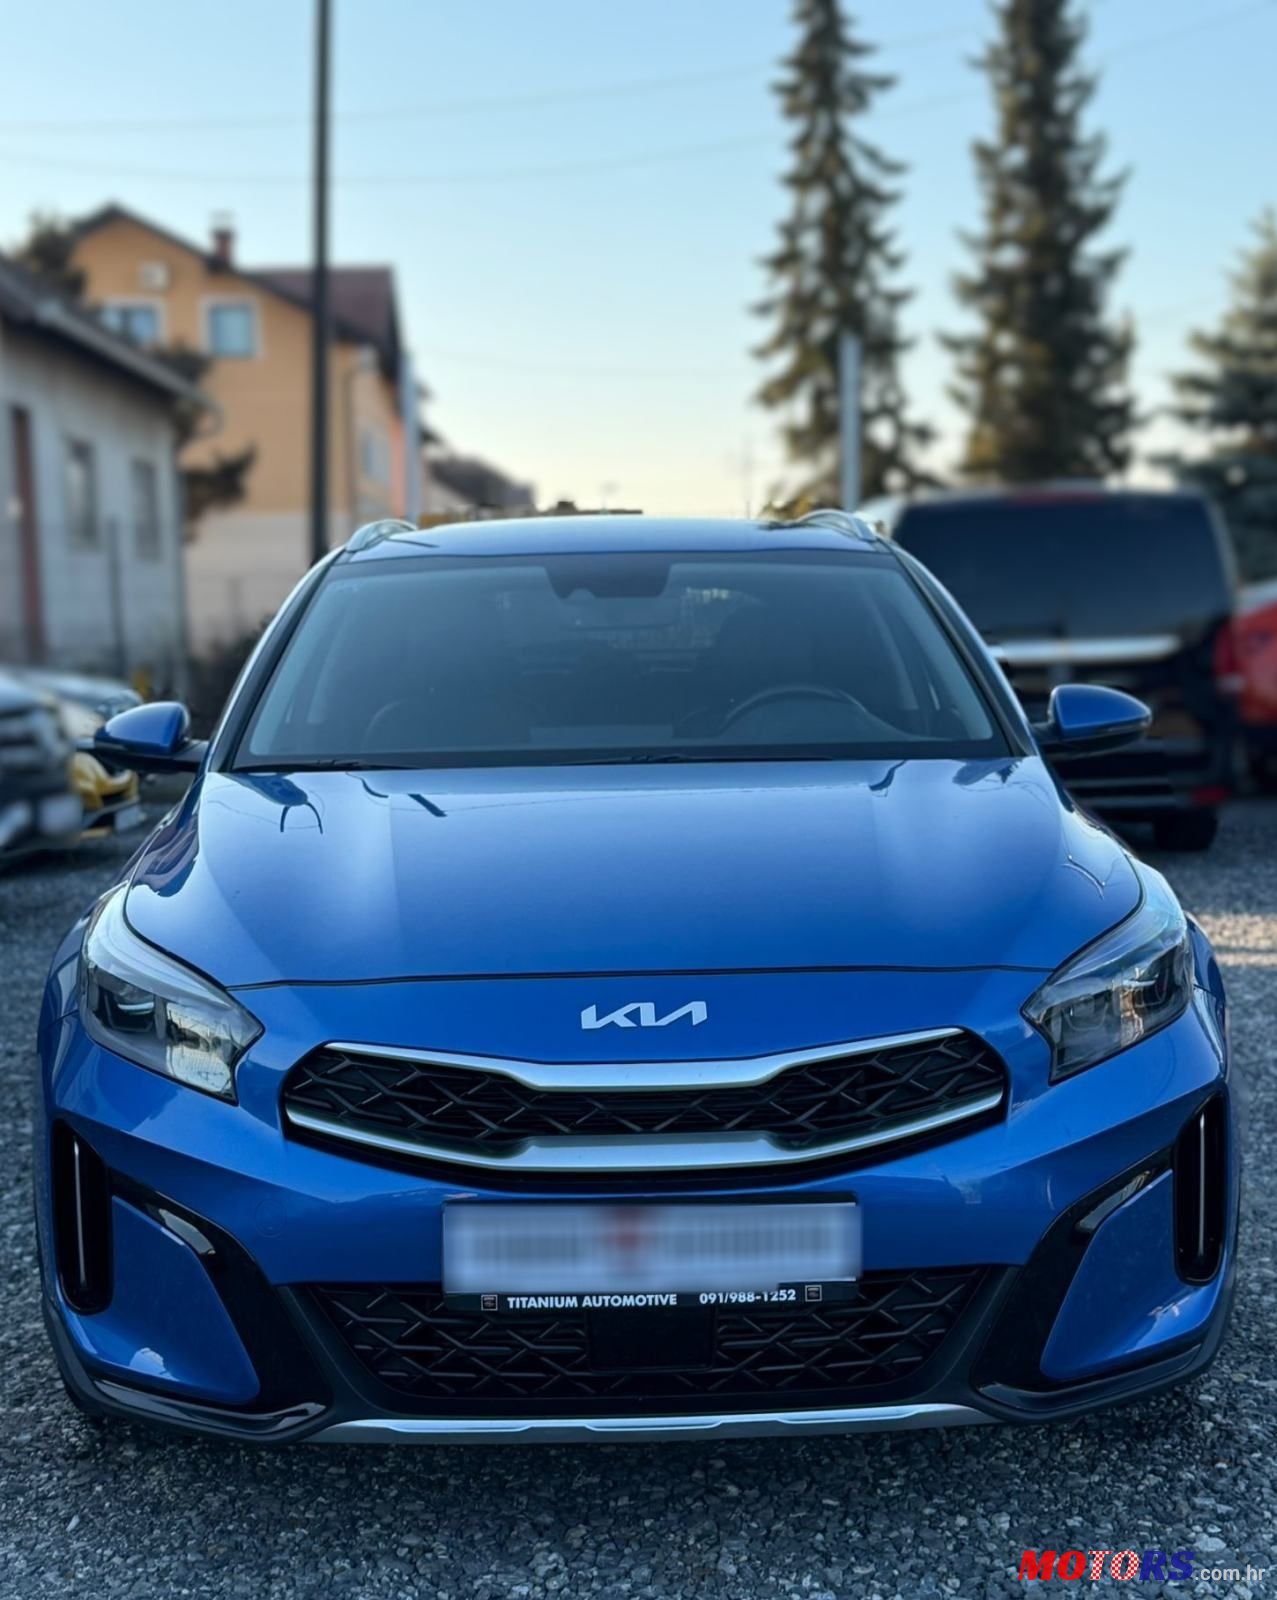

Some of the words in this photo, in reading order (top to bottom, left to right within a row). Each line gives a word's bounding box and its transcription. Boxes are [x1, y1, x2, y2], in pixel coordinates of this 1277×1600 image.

[581, 1001, 707, 1030] KIA
[507, 1296, 577, 1309] TITANIUM
[582, 1293, 677, 1308] AUTOMOTIVE
[699, 1289, 797, 1304] 091/988-1252
